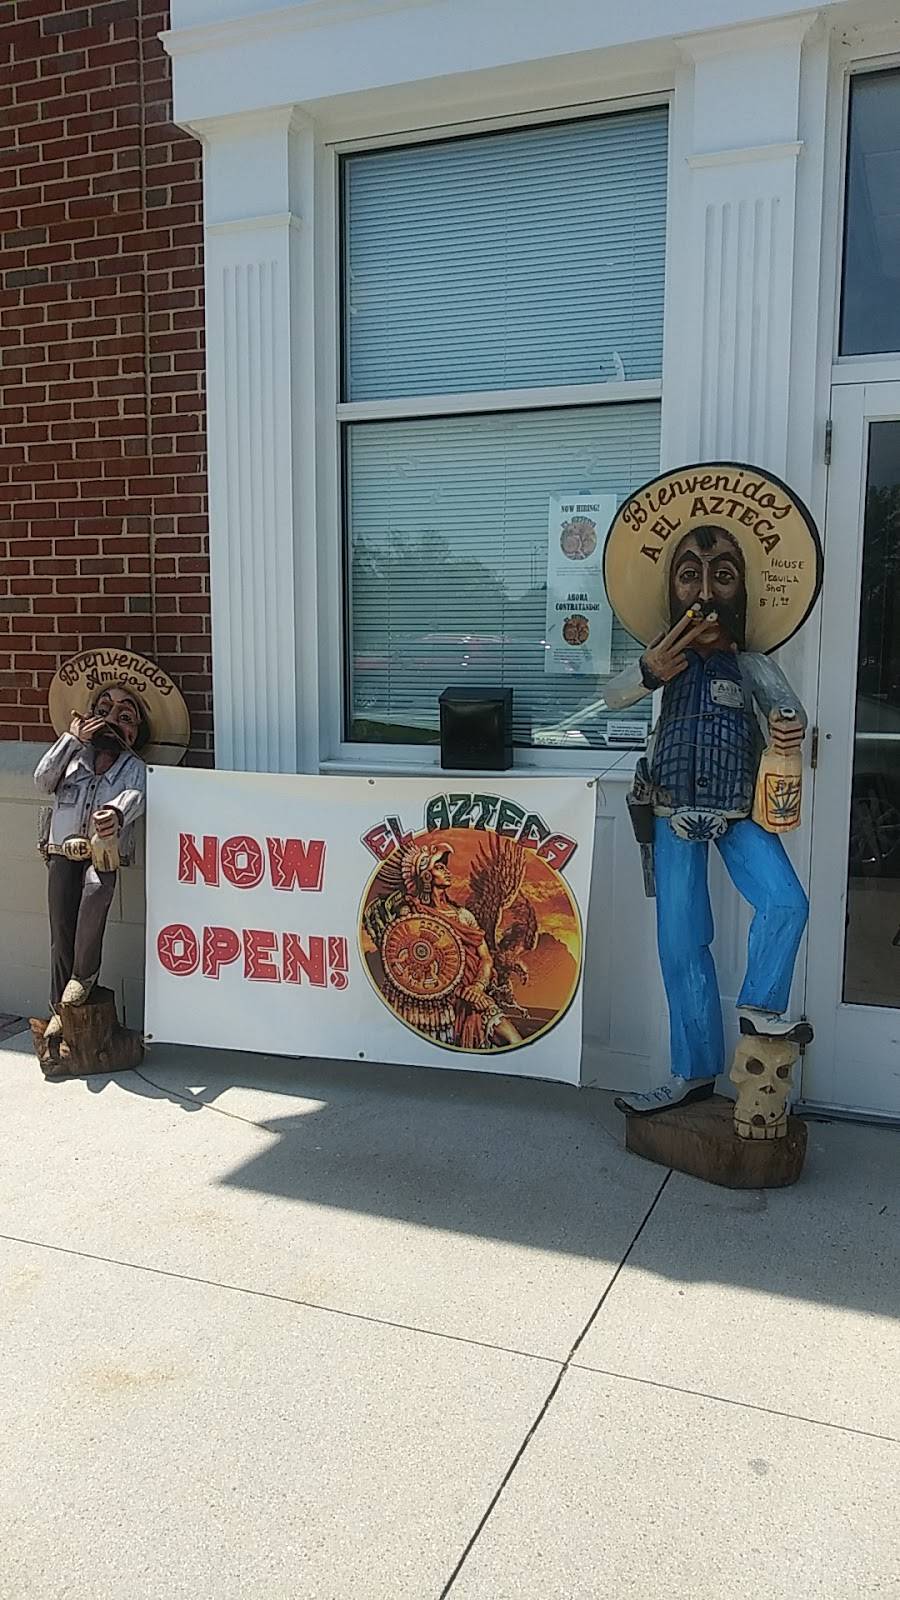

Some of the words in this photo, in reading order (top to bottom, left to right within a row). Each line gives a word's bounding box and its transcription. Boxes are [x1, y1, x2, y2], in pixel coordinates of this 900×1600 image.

[561, 505, 575, 513] NOW
[576, 504, 600, 513] HIRING!
[622, 471, 792, 532] Bienvenidos
[650, 514, 682, 542] EL
[690, 496, 782, 555] AZTECA
[640, 543, 664, 564] A
[771, 558, 805, 570] HOUSE
[567, 593, 588, 601] AHORA
[59, 651, 174, 696] Bienvenidos
[86, 667, 148, 693] Amigos
[362, 816, 415, 861] EL
[426, 792, 577, 871] AZTECA
[178, 832, 327, 892] NOW
[157, 923, 350, 991] OPEN!
